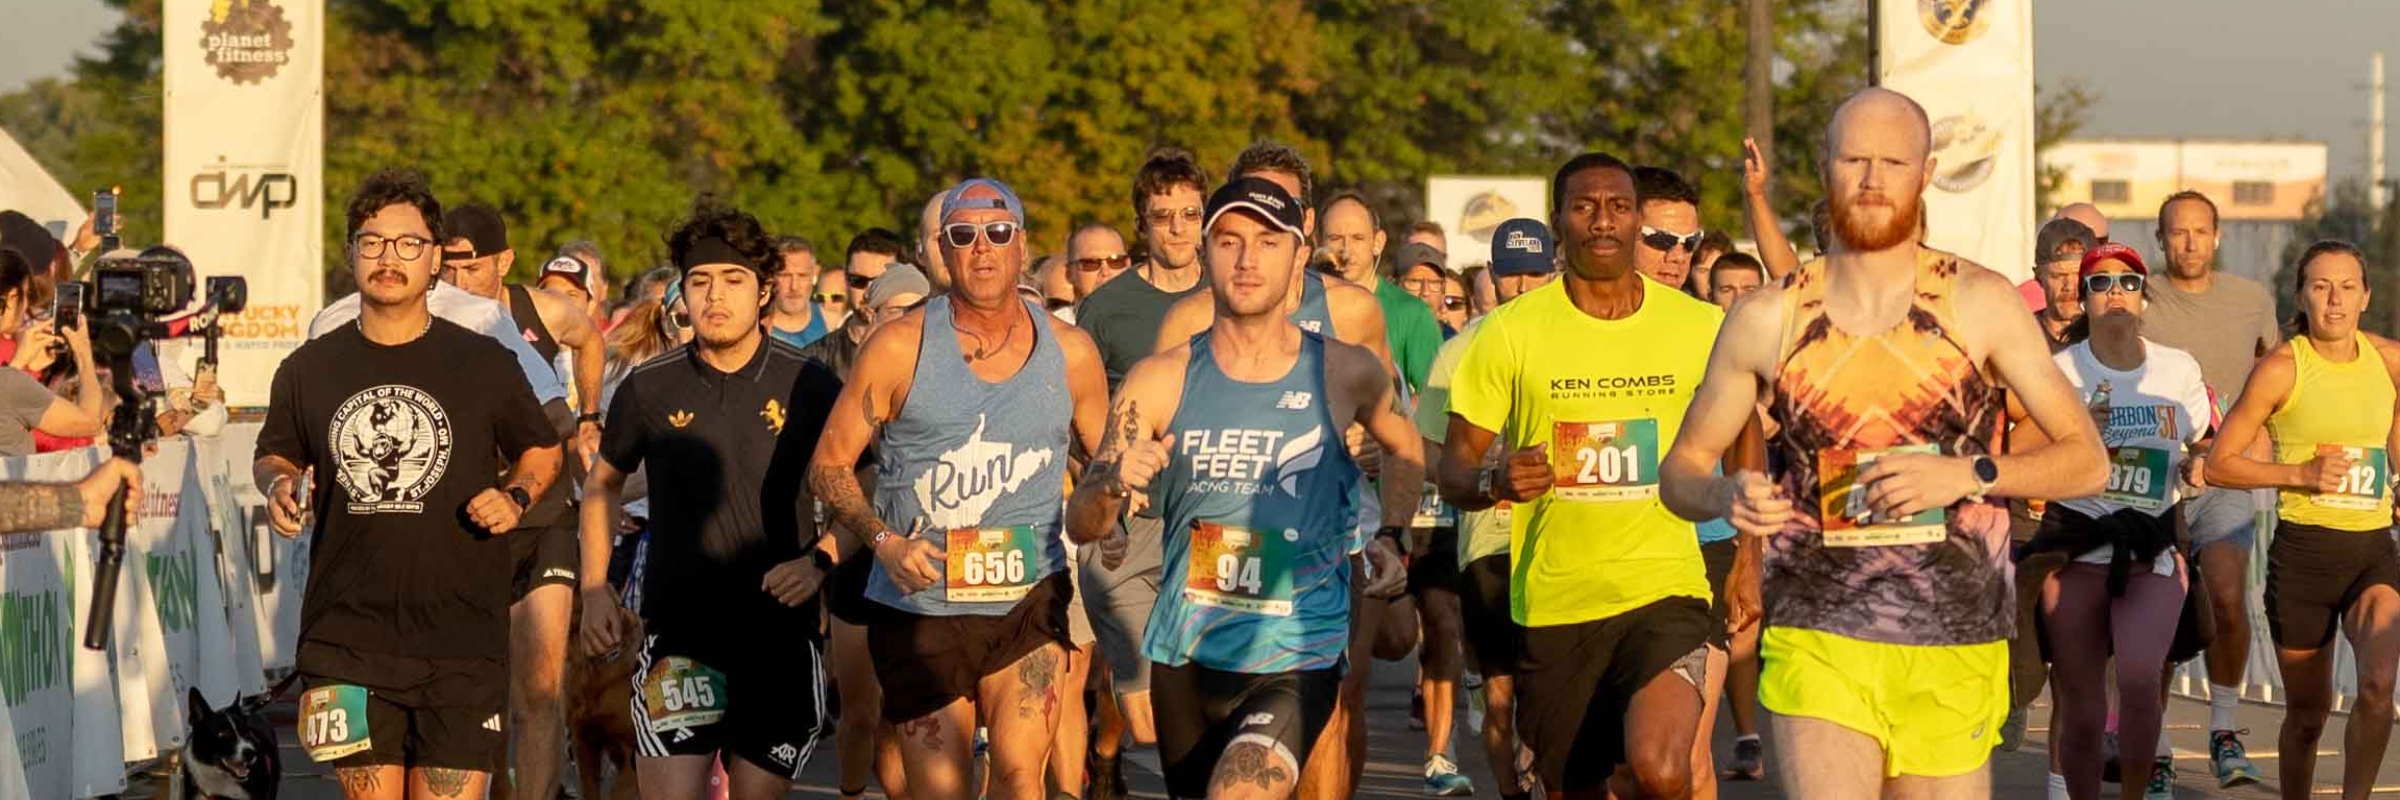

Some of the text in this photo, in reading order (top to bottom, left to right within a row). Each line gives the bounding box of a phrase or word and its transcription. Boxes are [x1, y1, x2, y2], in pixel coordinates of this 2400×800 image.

[207, 32, 271, 51] planet
[216, 48, 285, 62] fitness
[1550, 388, 1675, 399] RUNNING STORE
[1551, 375, 1676, 390] KEN COMBS
[338, 391, 376, 421] CAPITAL
[377, 387, 393, 397] OF
[394, 387, 416, 399] THE
[414, 391, 443, 421] WORLD
[2108, 404, 2179, 441] URBON 5K
[1182, 428, 1285, 456] FLEET
[1192, 454, 1273, 479] FEET
[1576, 445, 1639, 484] 201
[930, 454, 1015, 512] Run
[1234, 483, 1274, 497] TEAM
[964, 549, 1025, 586] 656
[1216, 553, 1262, 595] 94
[661, 675, 715, 712] 545
[306, 708, 349, 747] 473
